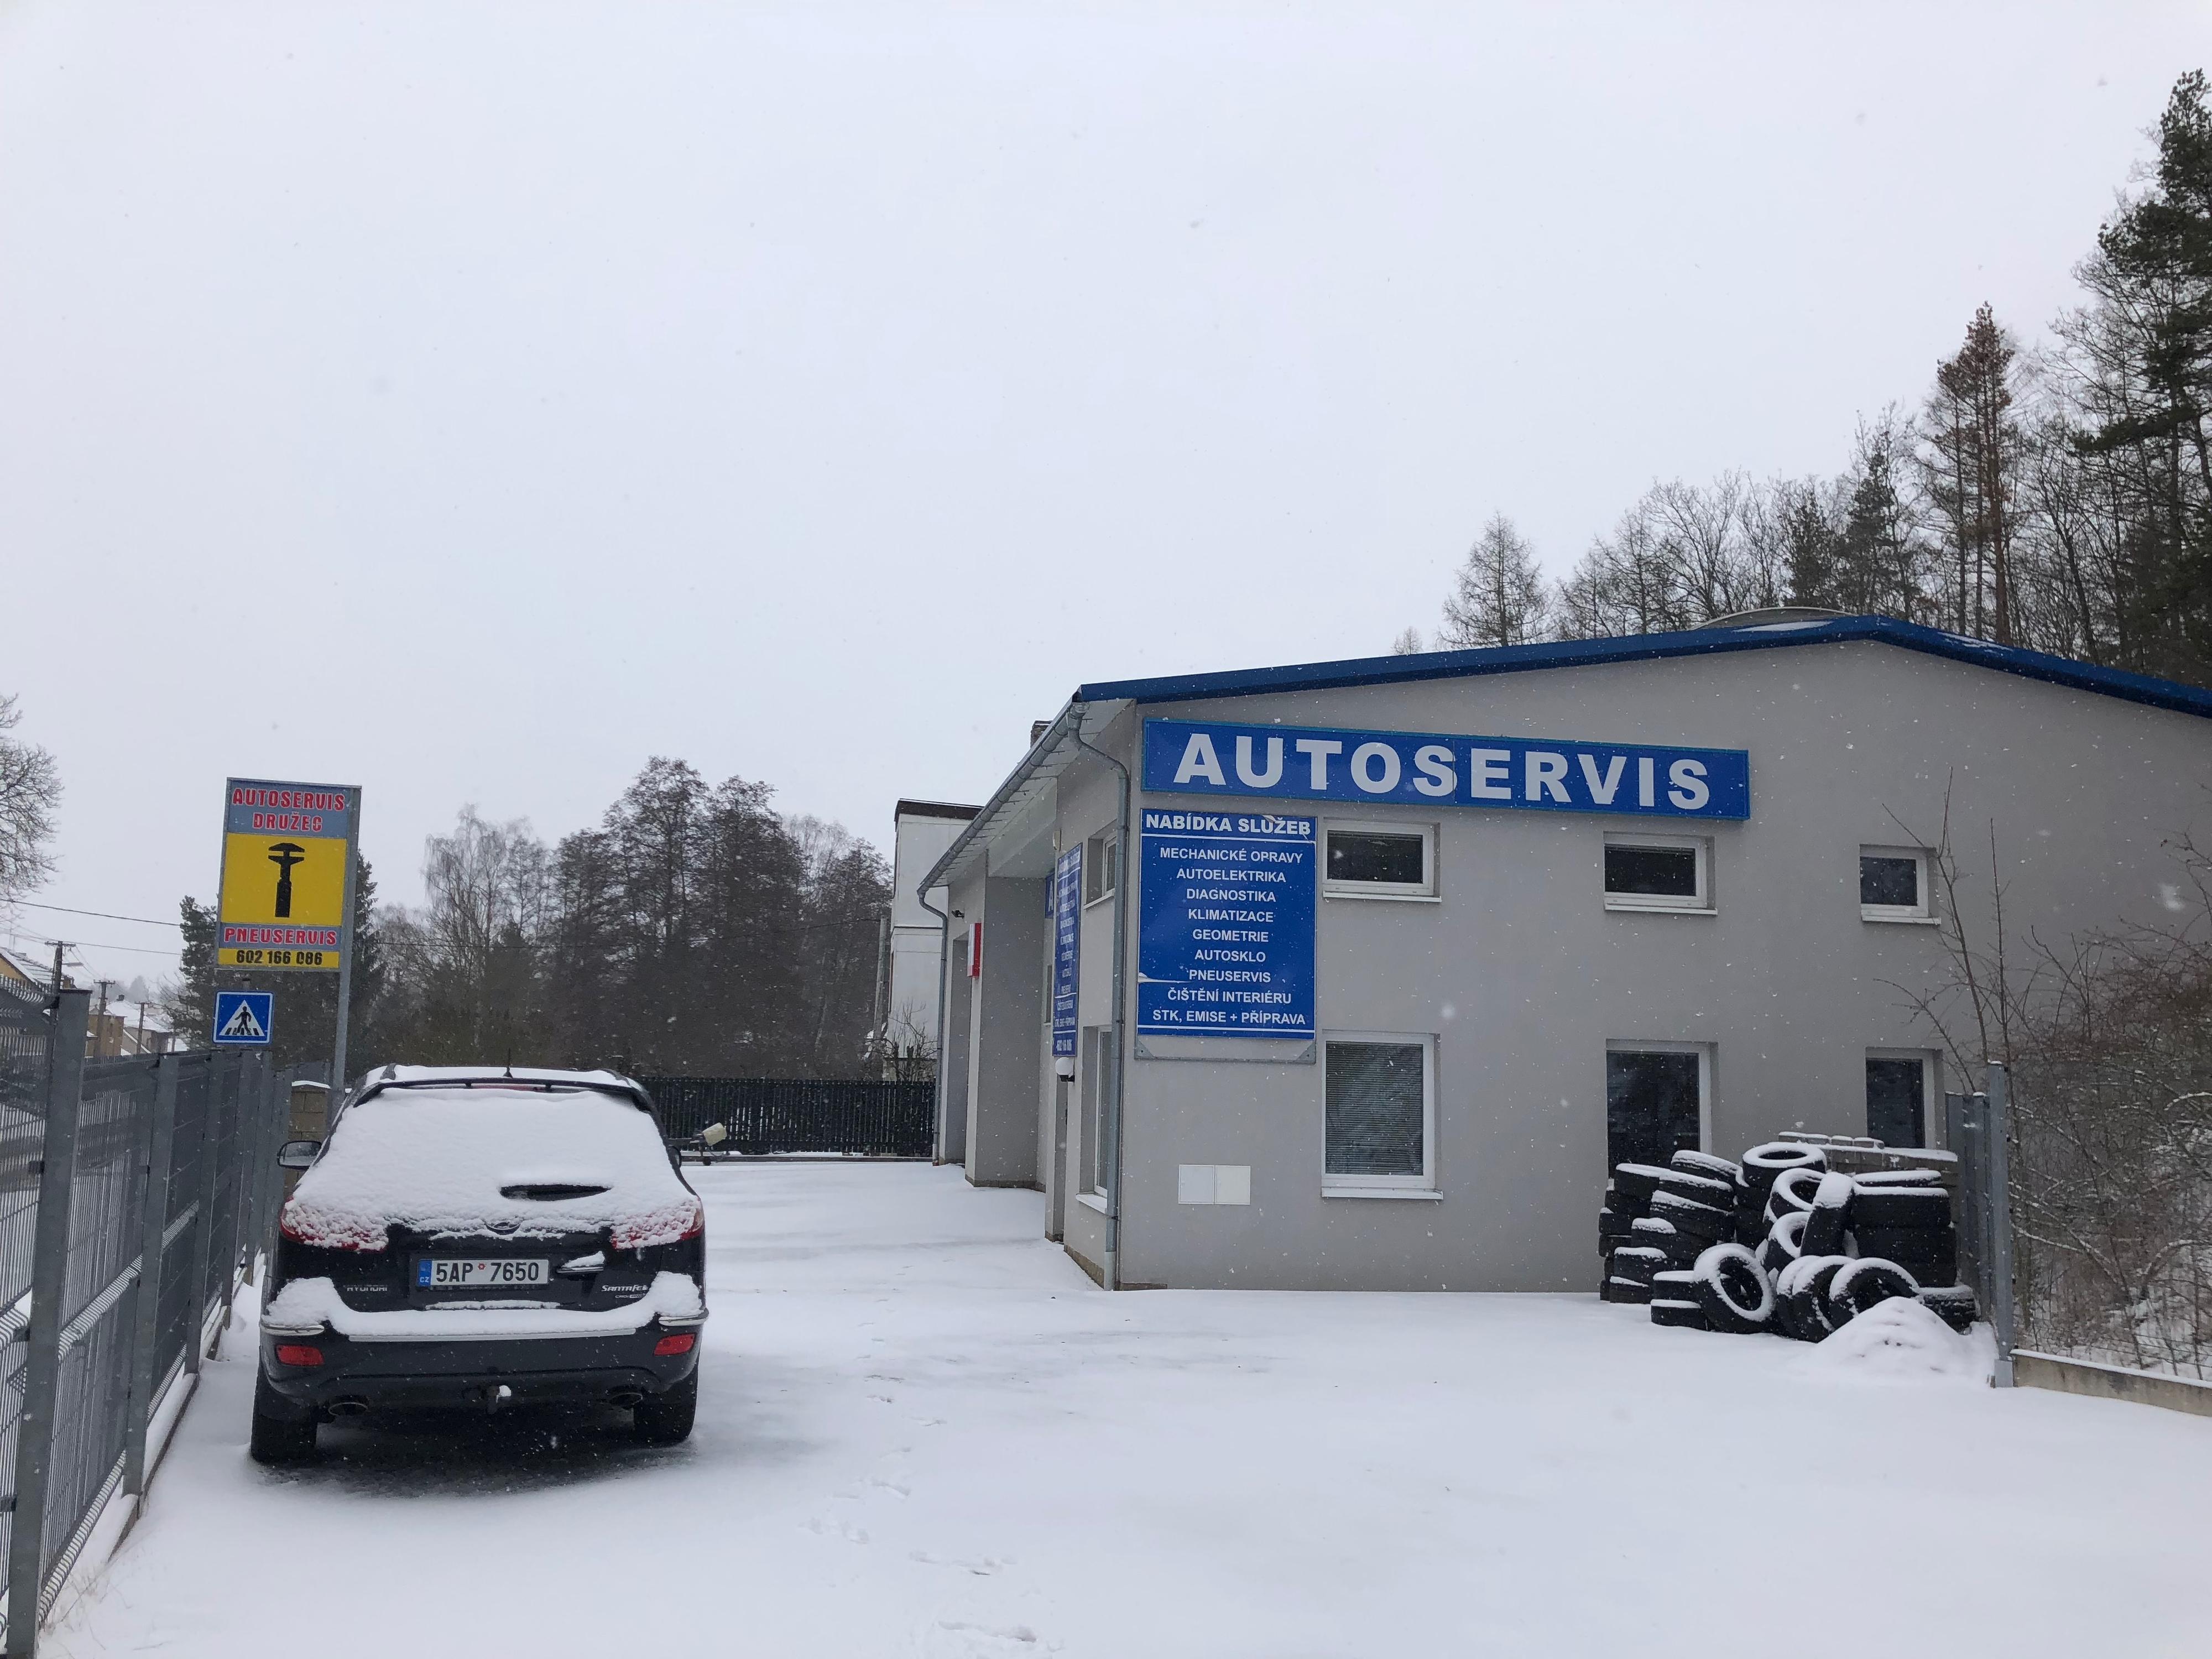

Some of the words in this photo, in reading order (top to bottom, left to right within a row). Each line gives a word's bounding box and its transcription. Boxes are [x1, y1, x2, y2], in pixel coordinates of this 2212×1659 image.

[1173, 733, 1710, 810] AUTOSERVIS
[232, 787, 345, 811] AUTOSERVIS
[252, 811, 323, 832] DRUŽEC
[1146, 813, 1232, 832] NABÍDKA
[1238, 817, 1311, 835] SLUŽEB
[1160, 847, 1247, 862] MECHANICKÉ
[1250, 851, 1303, 864] OPRAVY
[1176, 868, 1286, 883] AUTOELEKTRIKA
[1186, 888, 1276, 902] DIAGNOSTIKA
[1188, 909, 1274, 922] KLIMATIZACE
[223, 927, 337, 946] PNEUSERVIS
[1192, 928, 1269, 942] GEOMETRIE
[236, 950, 263, 964] 602
[267, 951, 291, 964] 166
[296, 951, 323, 966] 086
[1194, 949, 1266, 963] AUTOSKLO
[1188, 969, 1271, 983] PNEUSERVIS
[1167, 987, 1219, 1002] ČIŠTĚNÍ
[1222, 989, 1292, 1004] INTERIÉRU
[1152, 1010, 1182, 1022] STK,
[1186, 1010, 1227, 1023] EMISE
[1241, 1010, 1306, 1025] PŘÍPRAVA
[436, 1262, 473, 1282] 5AP
[489, 1262, 540, 1282] 7650
